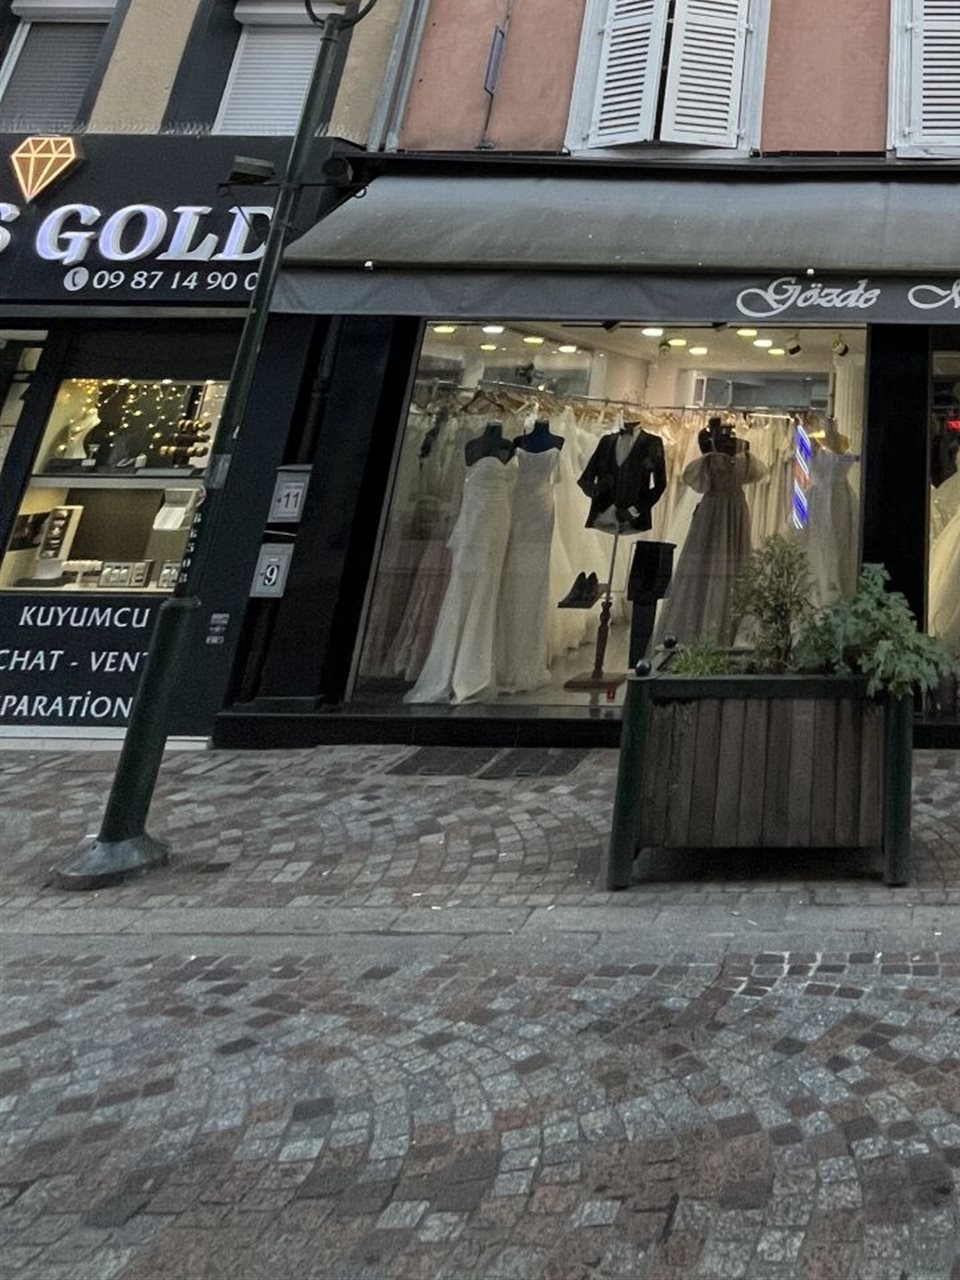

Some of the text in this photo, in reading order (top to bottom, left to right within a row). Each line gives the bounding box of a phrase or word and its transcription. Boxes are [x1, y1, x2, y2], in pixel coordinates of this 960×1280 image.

[35, 203, 276, 265] GOLD
[93, 271, 124, 289] 09
[130, 271, 160, 289] 87
[171, 271, 198, 290] 14
[206, 272, 237, 290] 90
[736, 276, 881, 318] Gözde
[283, 491, 301, 509] 11
[264, 565, 278, 586] 9
[18, 606, 151, 628] KUYUMCU
